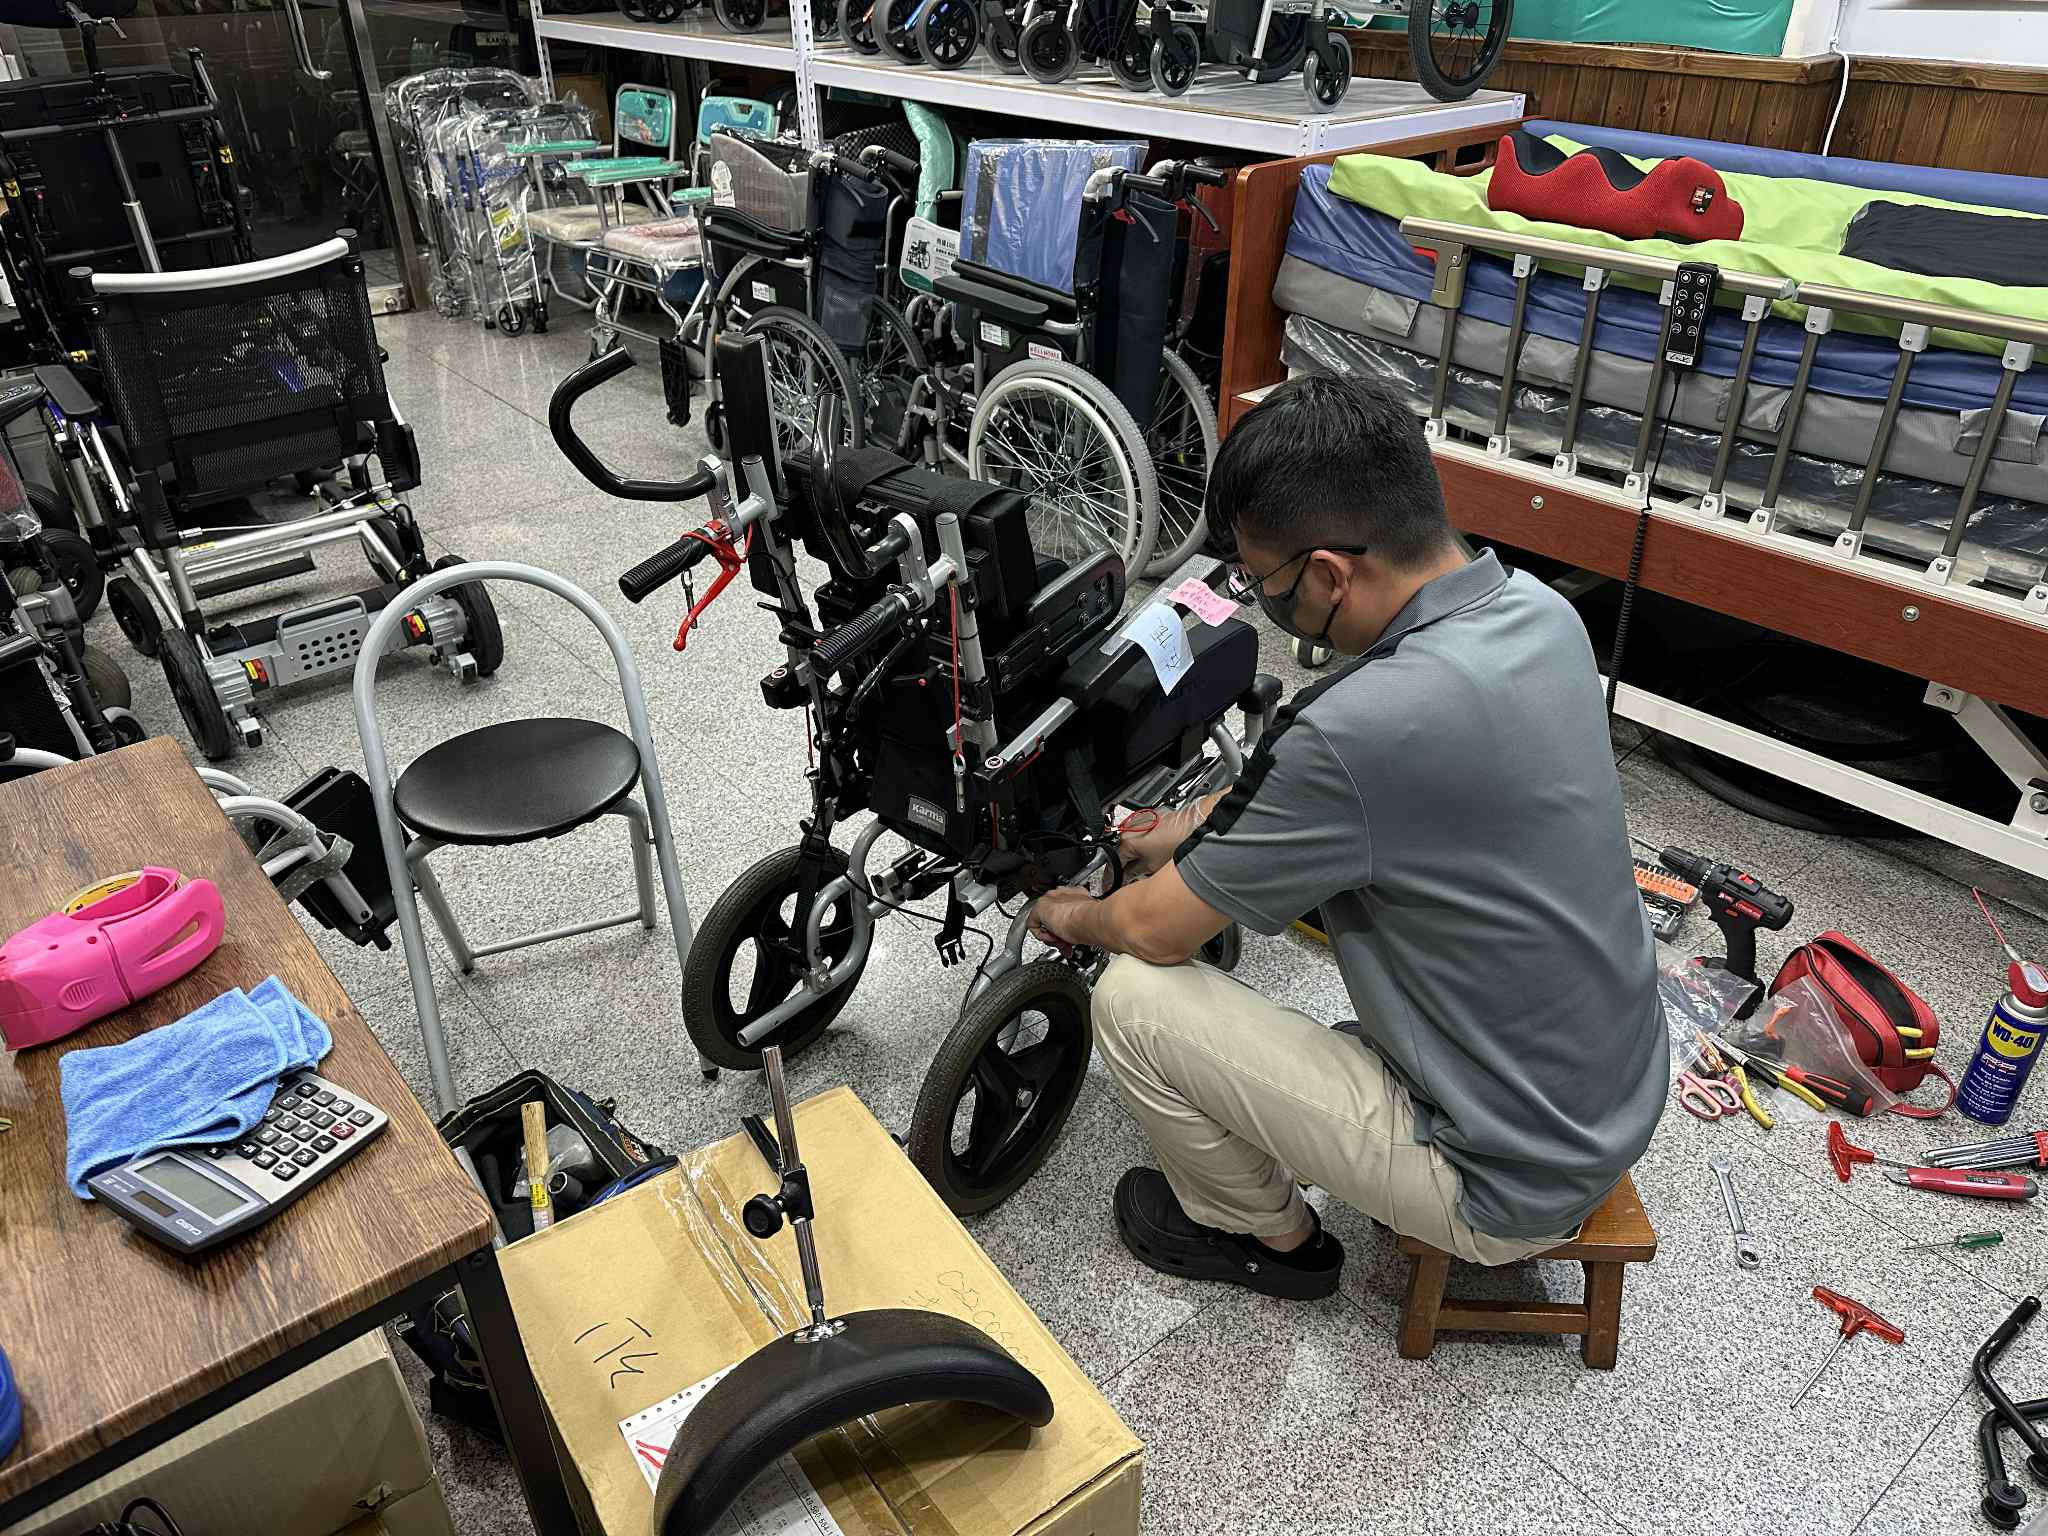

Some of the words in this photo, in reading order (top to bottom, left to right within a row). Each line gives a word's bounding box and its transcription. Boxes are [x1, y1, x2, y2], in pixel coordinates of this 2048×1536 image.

[912, 804, 944, 824] Karma
[1992, 1022, 2035, 1049] WD-40
[175, 1218, 203, 1237] CASIO
